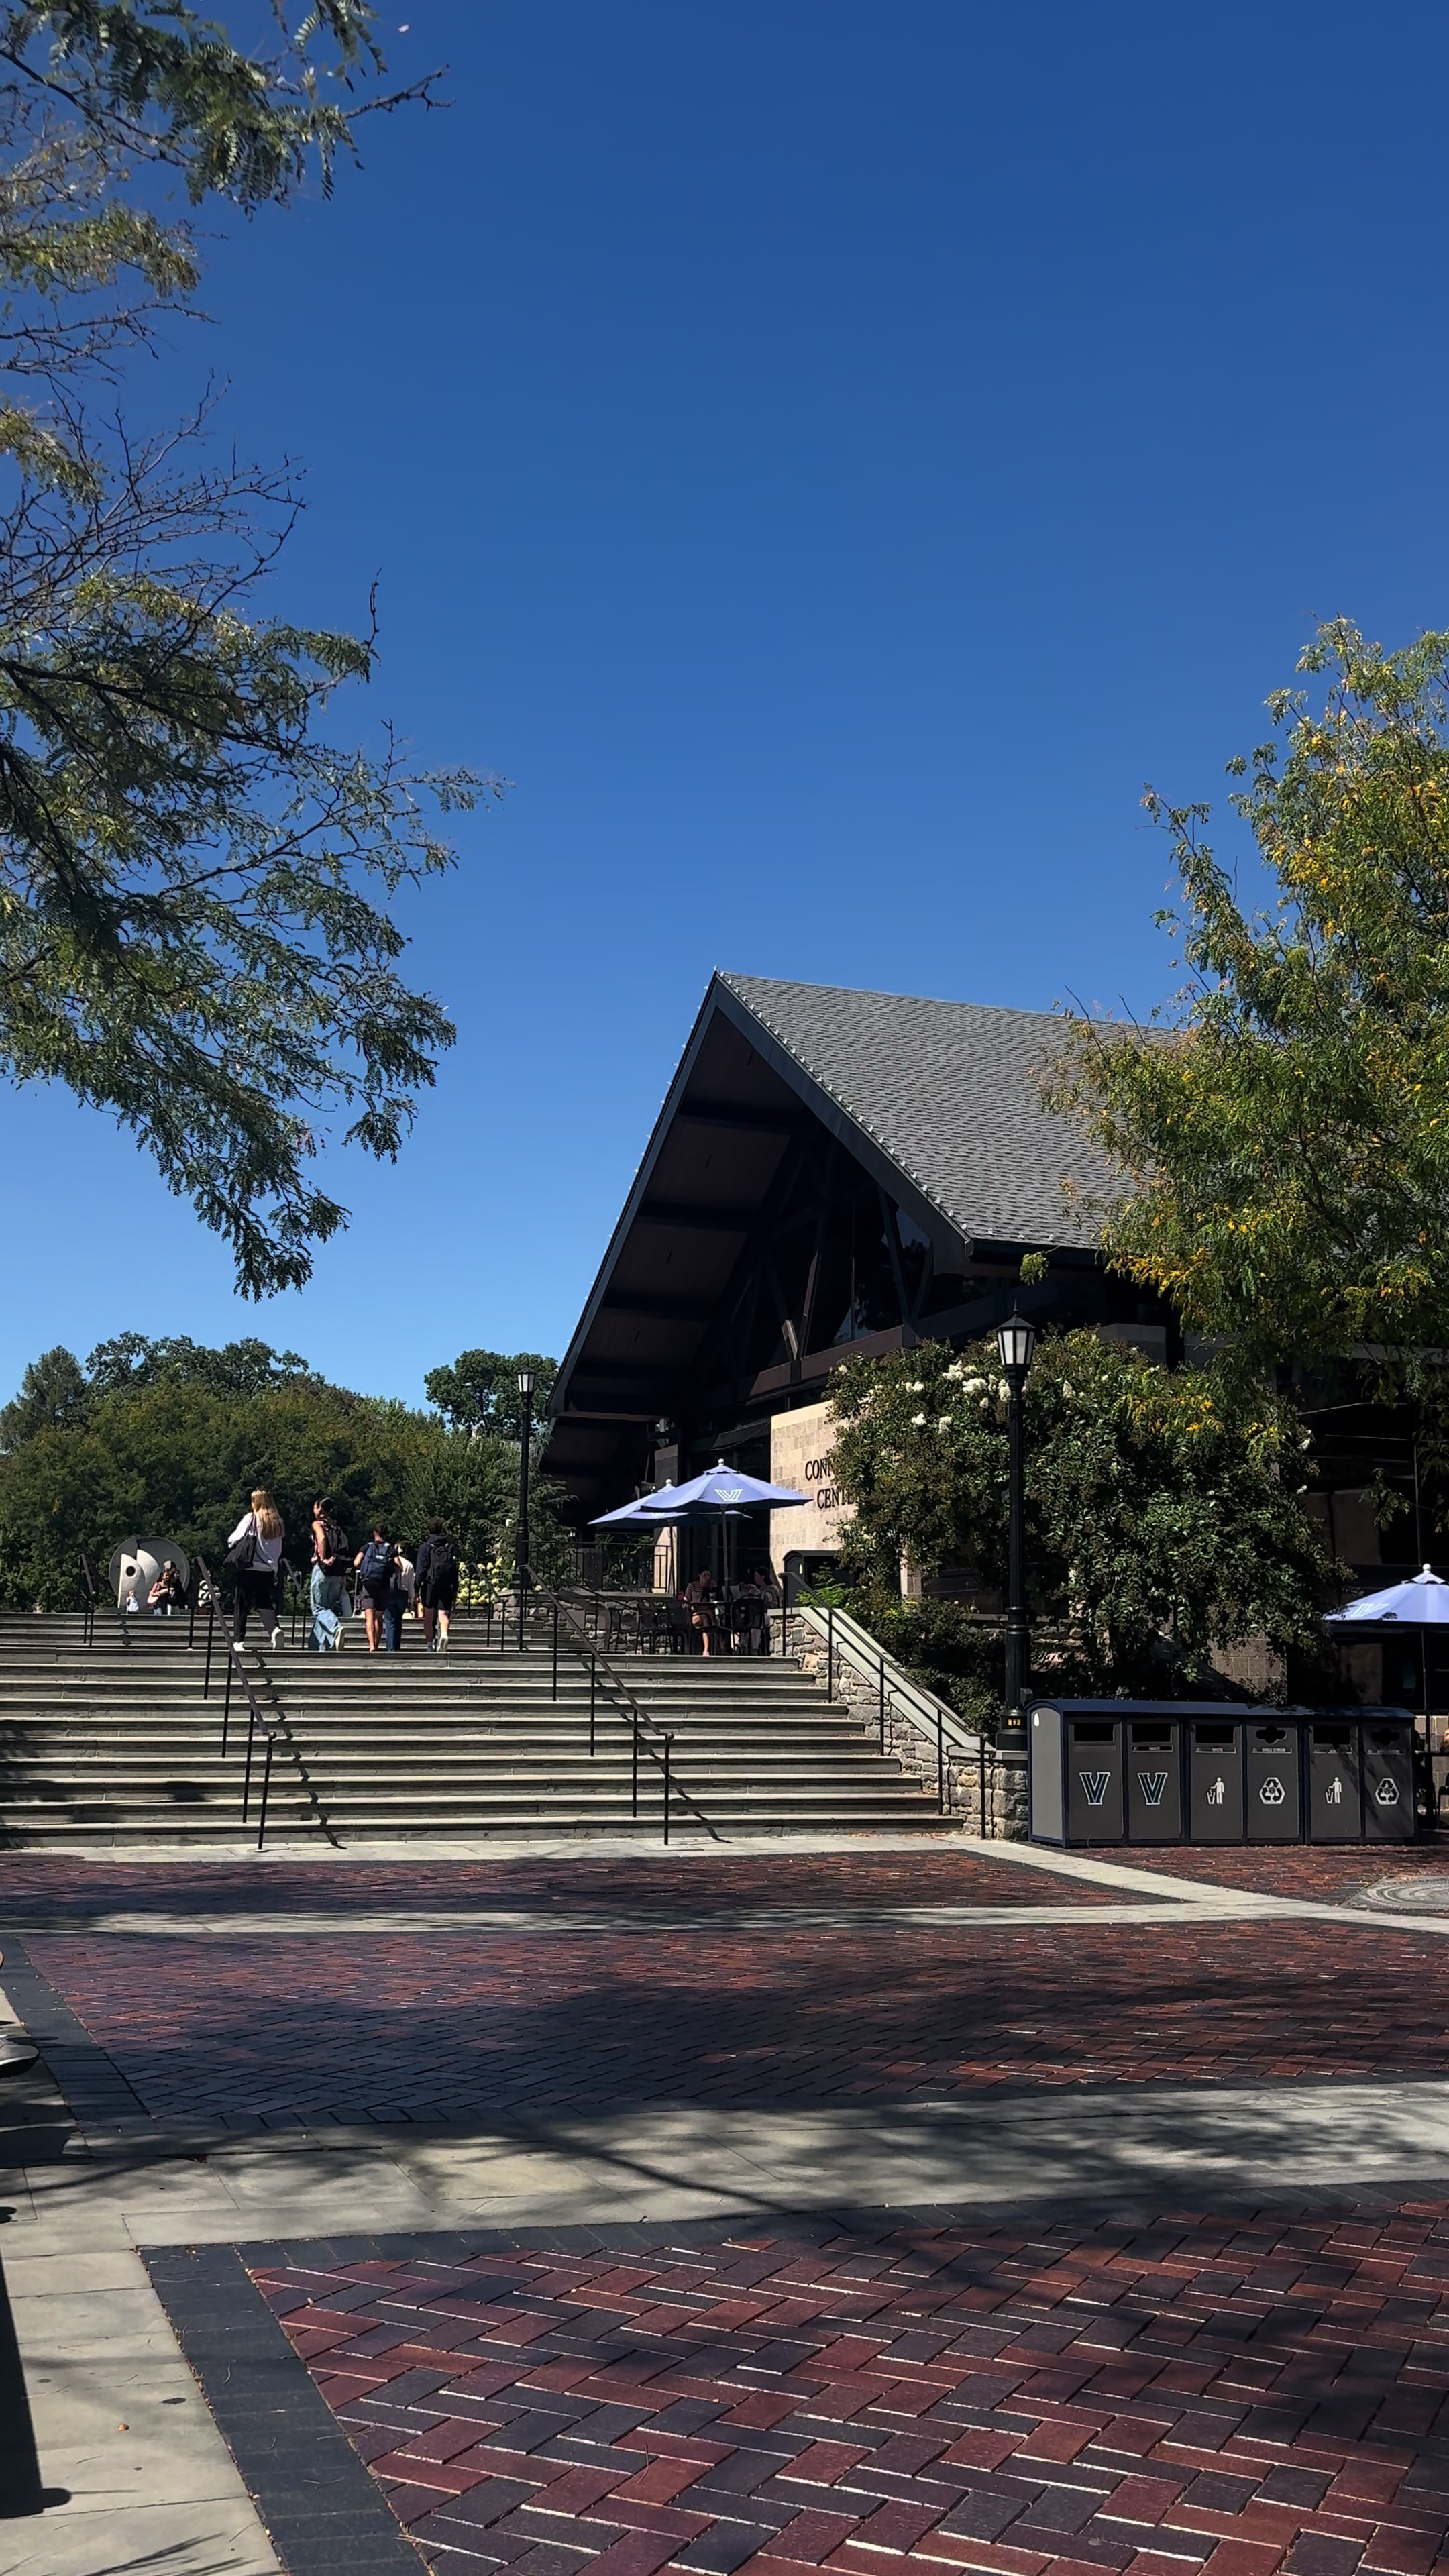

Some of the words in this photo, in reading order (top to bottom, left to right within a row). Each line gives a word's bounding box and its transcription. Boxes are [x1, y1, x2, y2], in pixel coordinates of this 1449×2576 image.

[805, 1456, 835, 1481] CONN
[714, 1489, 743, 1502] V
[817, 1486, 855, 1509] CENTE
[1079, 1772, 1110, 1805] V
[1137, 1772, 1168, 1805] V
